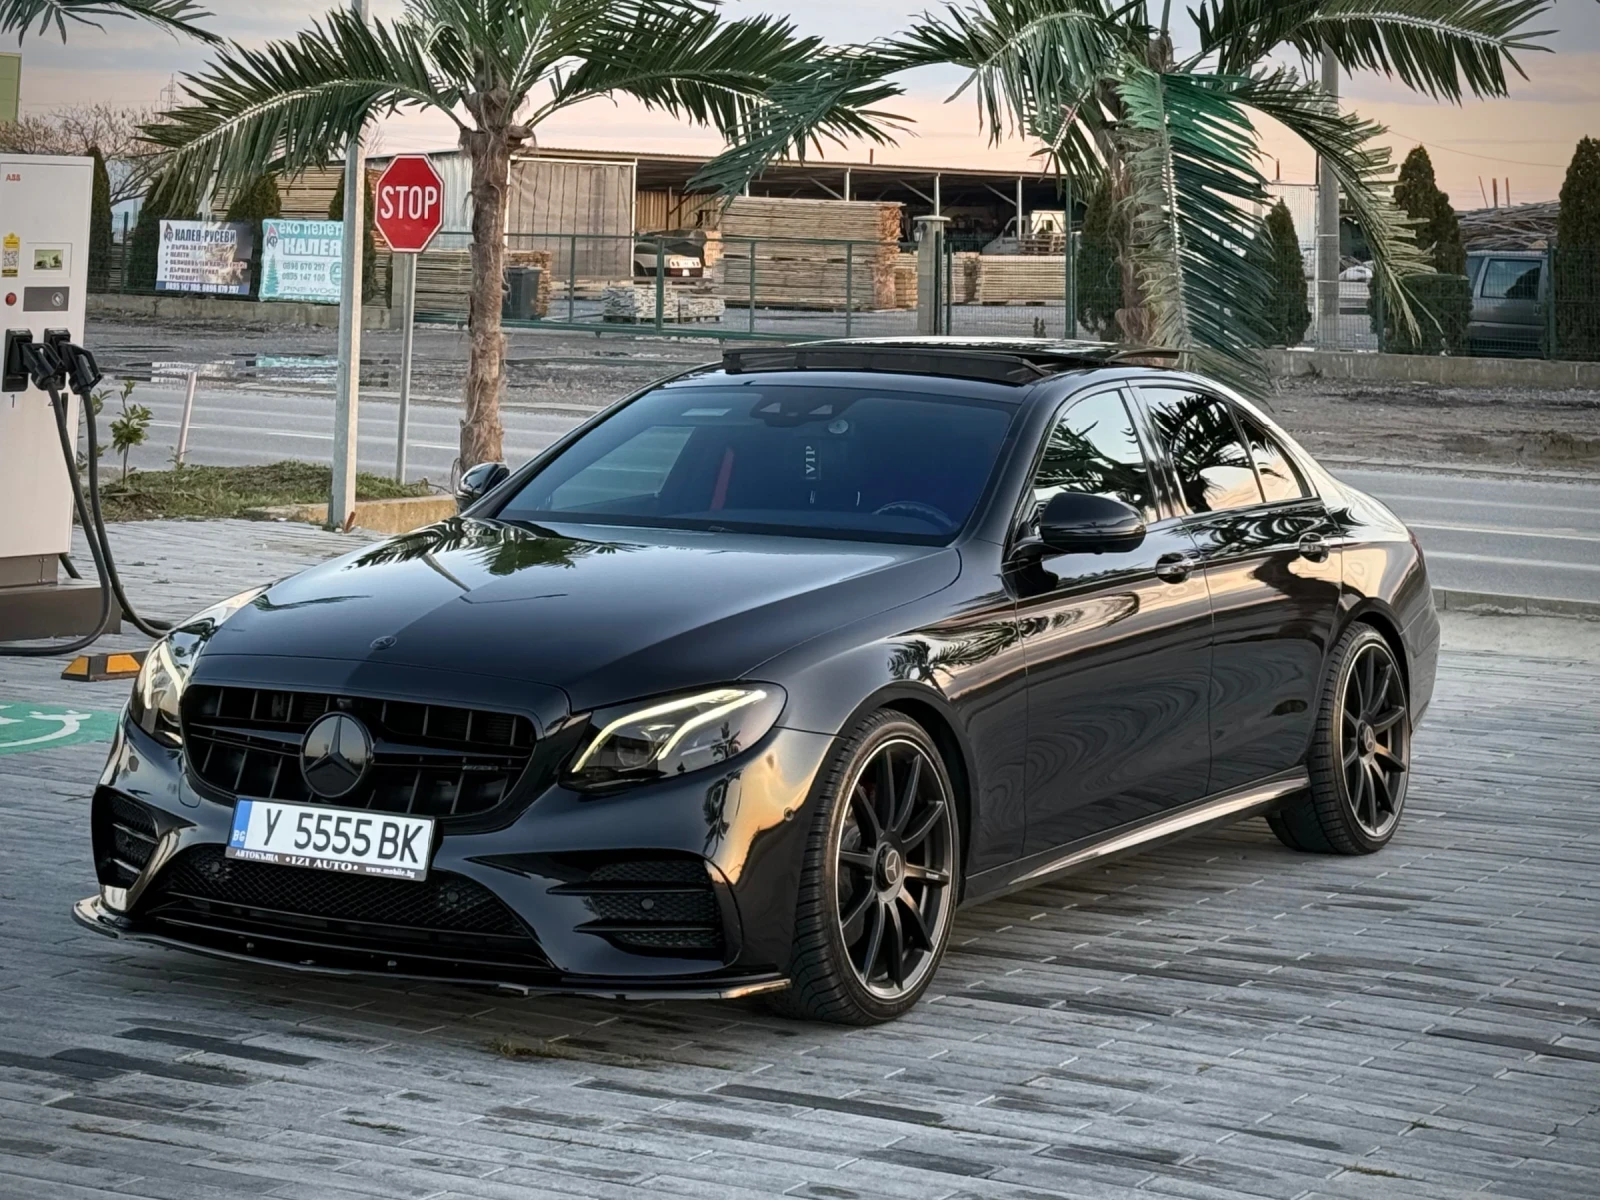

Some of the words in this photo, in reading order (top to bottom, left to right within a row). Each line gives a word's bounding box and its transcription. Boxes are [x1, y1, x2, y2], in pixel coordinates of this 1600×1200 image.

[380, 185, 438, 219] STOP
[175, 228, 236, 243] КАЛЕЯ-РУСЕВИ
[304, 223, 343, 236] пелет
[283, 238, 342, 257] КАЛЕЯ
[10, 393, 15, 408] 1
[805, 445, 816, 475] VIP
[233, 829, 246, 842] BG
[294, 812, 372, 857] 5555
